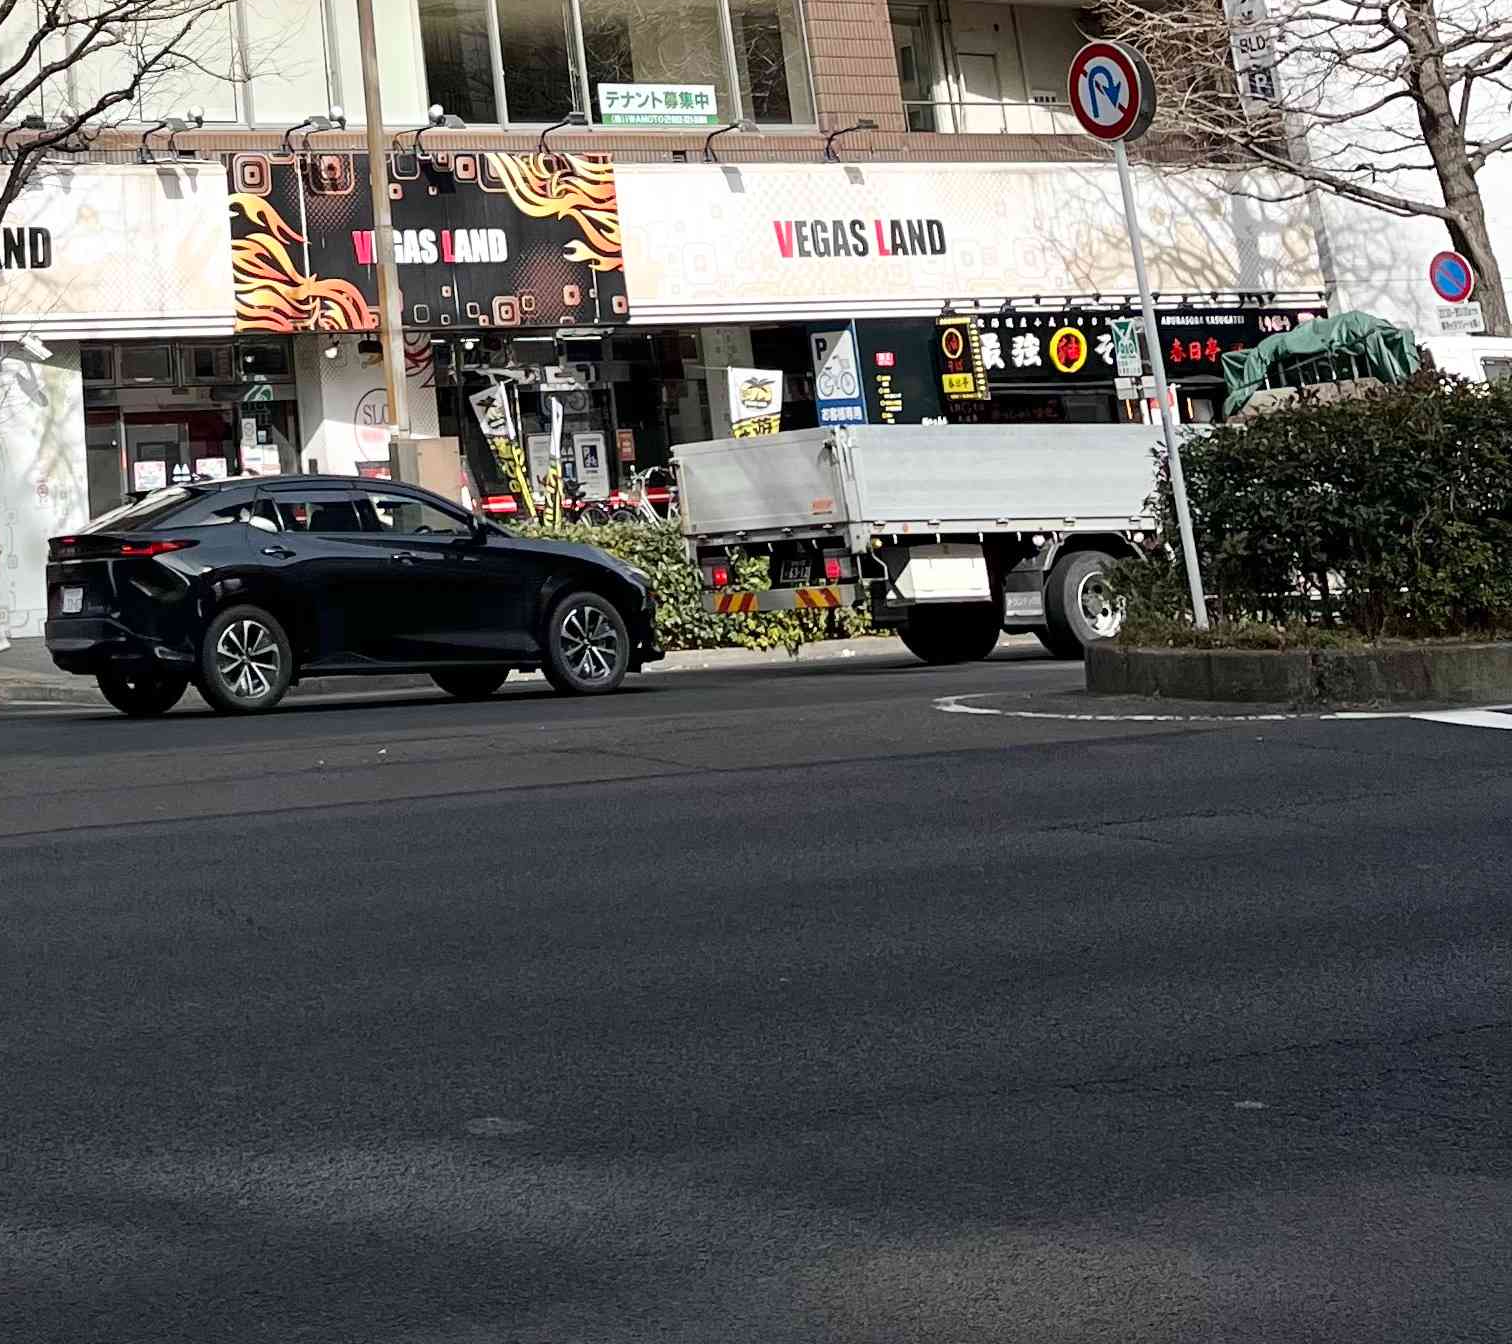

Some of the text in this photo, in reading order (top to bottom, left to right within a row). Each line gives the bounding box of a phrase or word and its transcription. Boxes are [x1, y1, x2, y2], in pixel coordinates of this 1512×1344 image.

[605, 90, 709, 110] テナント募集中
[441, 229, 508, 264] LAND
[773, 218, 947, 259] VEGAS LAND
[815, 337, 828, 361] P
[1169, 331, 1222, 363] 春日亭
